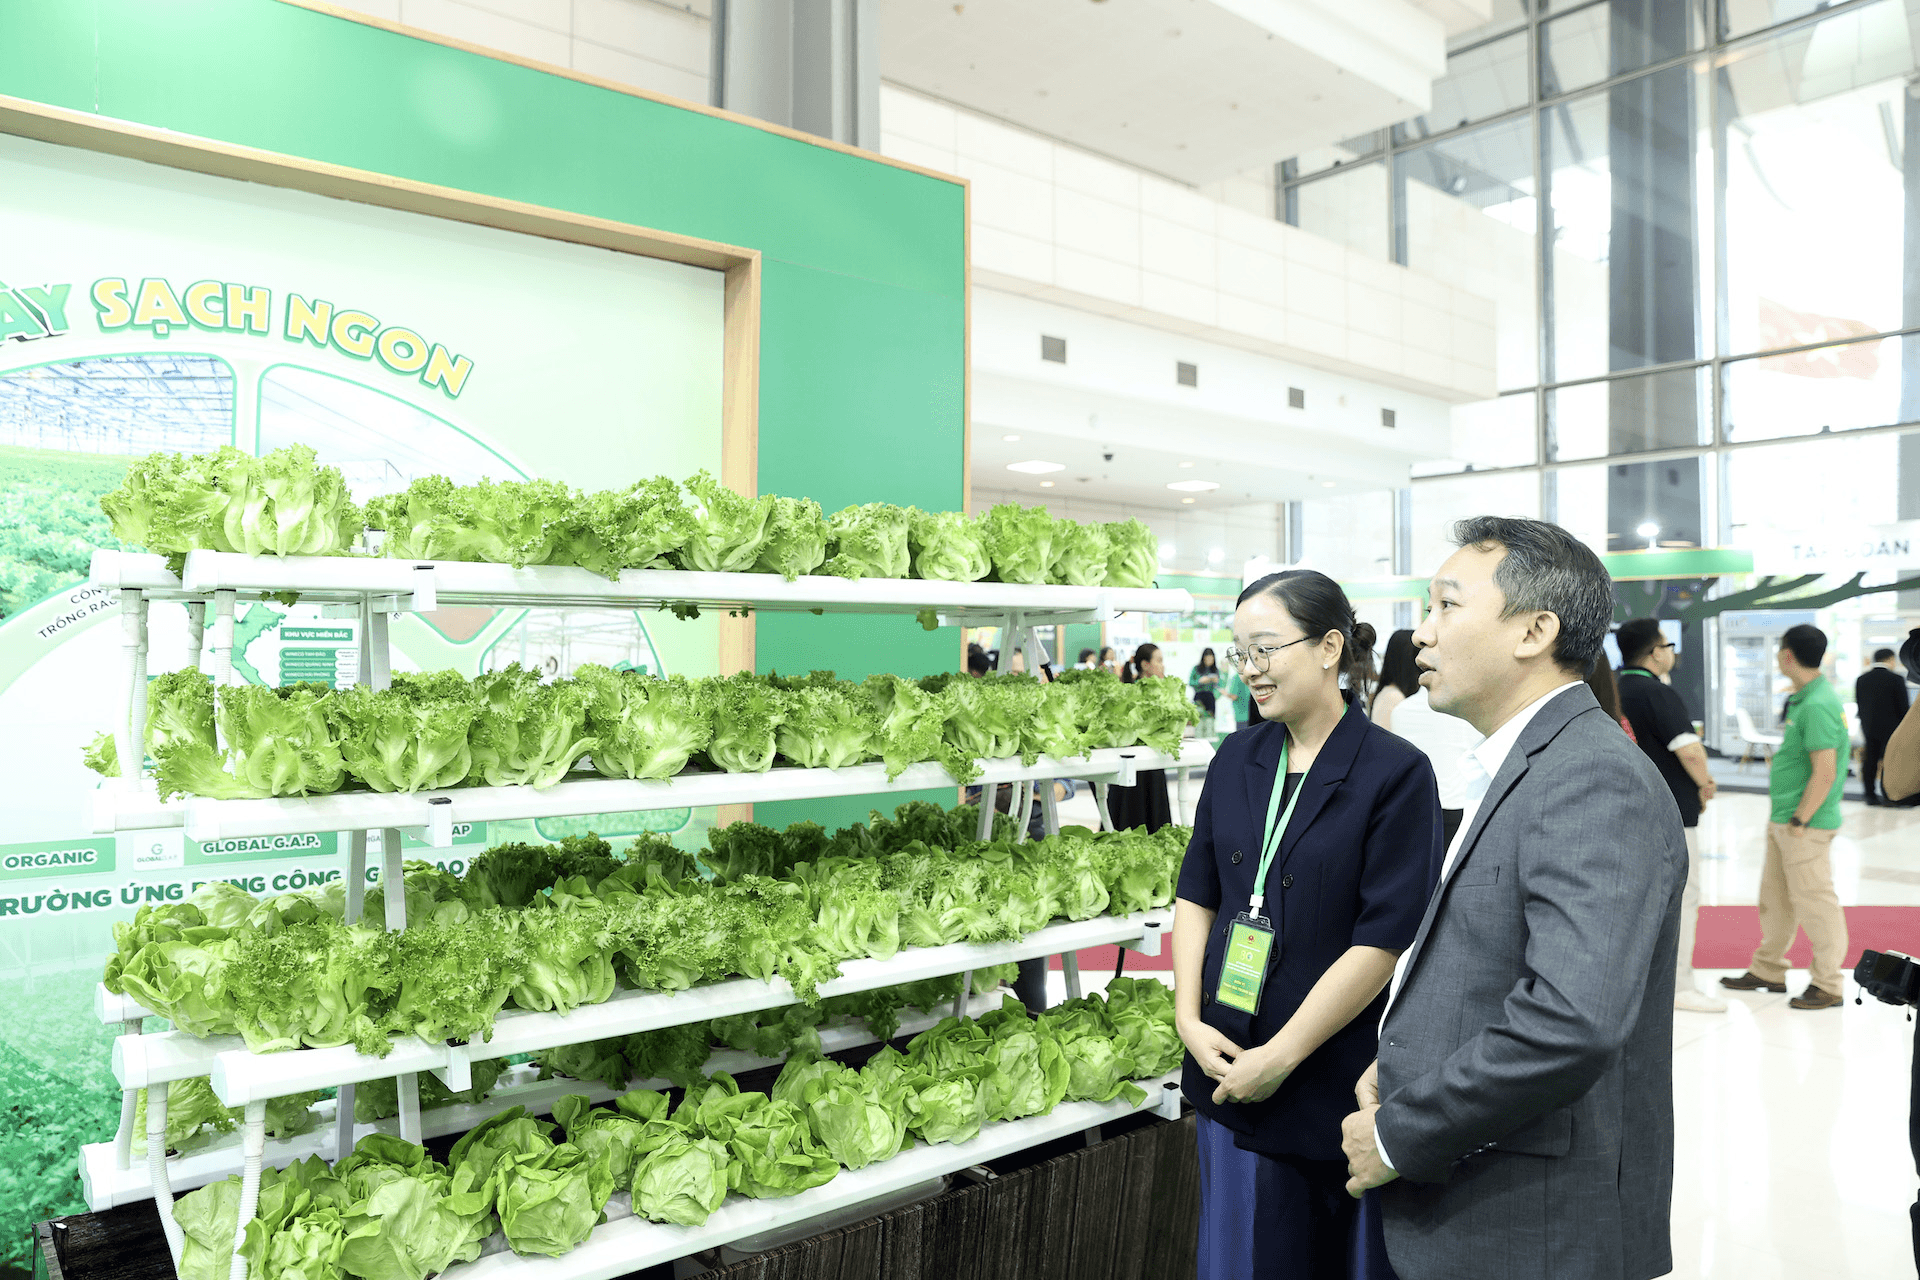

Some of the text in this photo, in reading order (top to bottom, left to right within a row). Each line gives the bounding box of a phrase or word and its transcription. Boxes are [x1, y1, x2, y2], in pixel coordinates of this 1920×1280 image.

[90, 277, 272, 339] SẠCH
[283, 293, 475, 400] NGON
[203, 836, 319, 853] GLOBAL G.A.P.
[4, 851, 95, 868] ORGANIC
[120, 882, 183, 905] ỨNG
[272, 869, 342, 891] CÔNG
